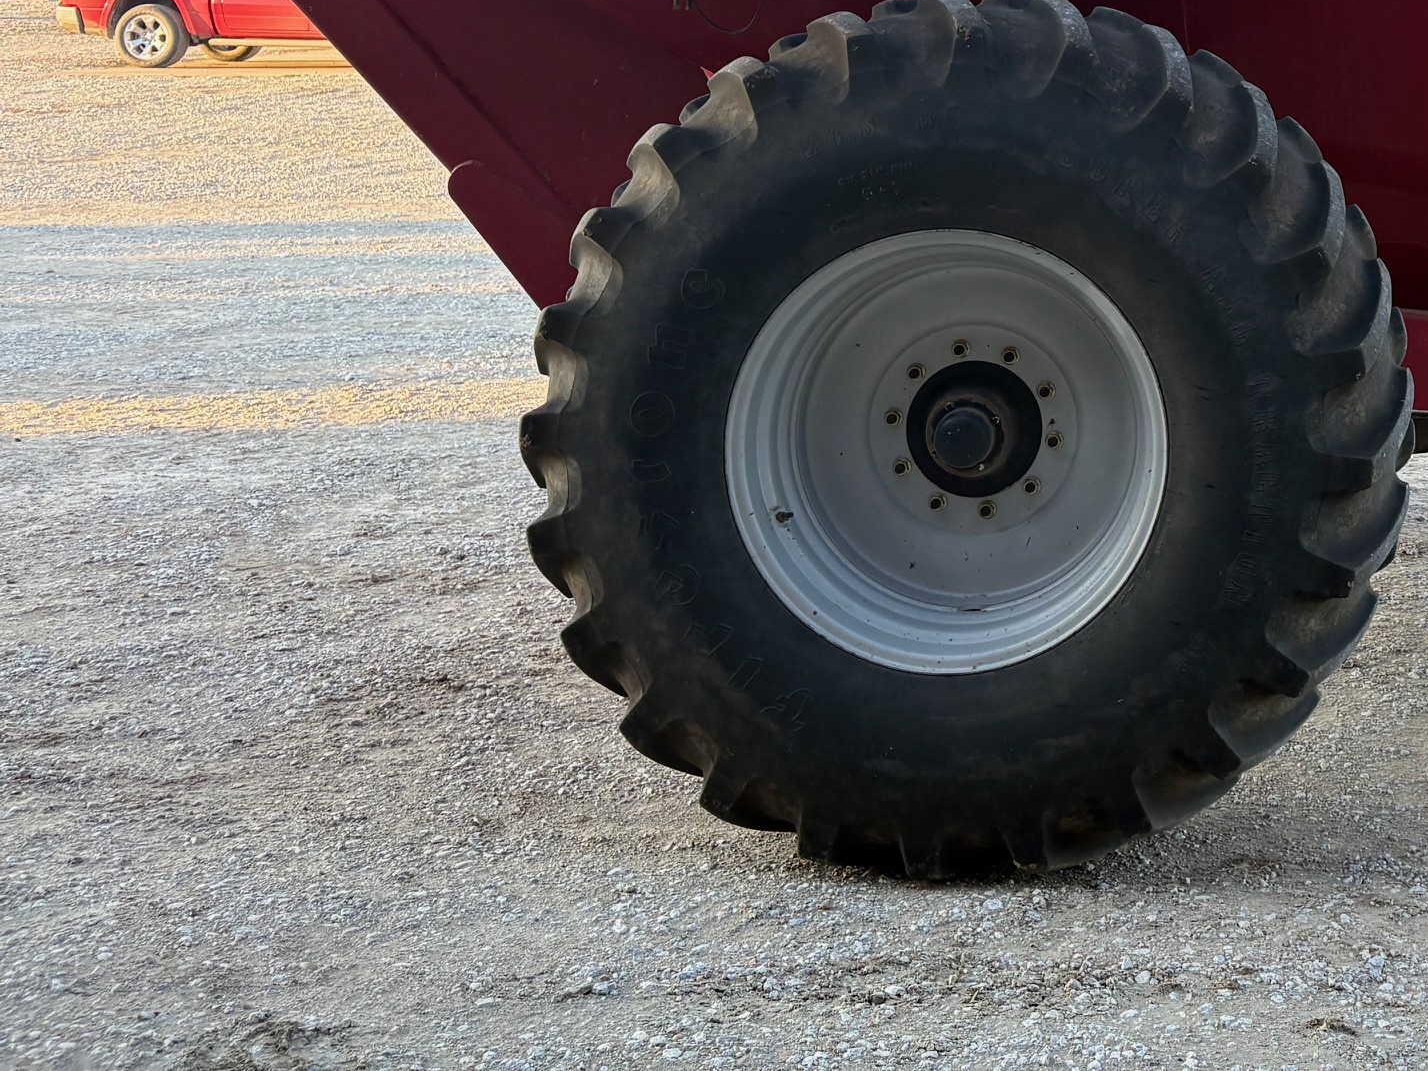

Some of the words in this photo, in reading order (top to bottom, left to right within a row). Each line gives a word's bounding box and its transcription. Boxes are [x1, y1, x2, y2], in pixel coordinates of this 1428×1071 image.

[1201, 263, 1257, 346] ALL
[629, 269, 812, 731] Firestone
[1220, 372, 1281, 607] TRACTION
